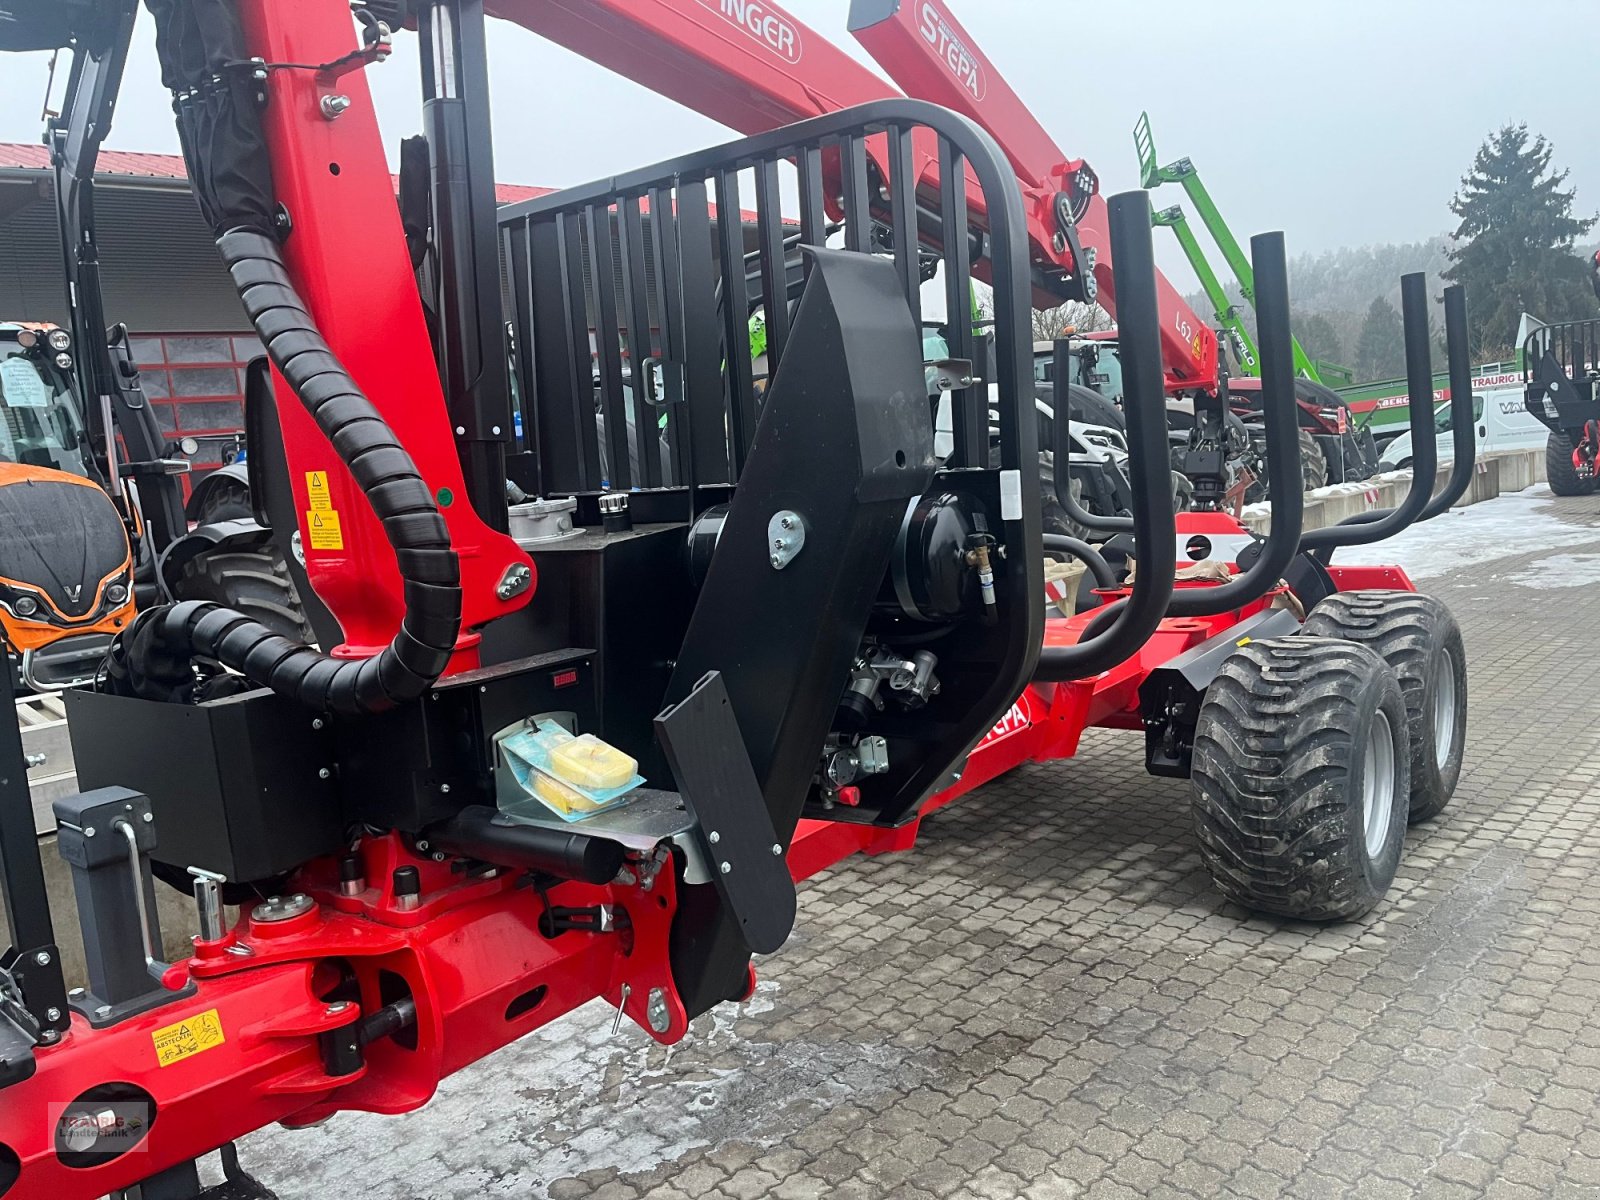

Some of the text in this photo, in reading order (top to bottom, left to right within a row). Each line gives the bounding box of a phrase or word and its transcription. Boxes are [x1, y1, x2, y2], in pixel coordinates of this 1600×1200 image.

[920, 2, 978, 97] STEPA
[1175, 311, 1192, 344] L62
[1472, 374, 1514, 387] TRAURIG
